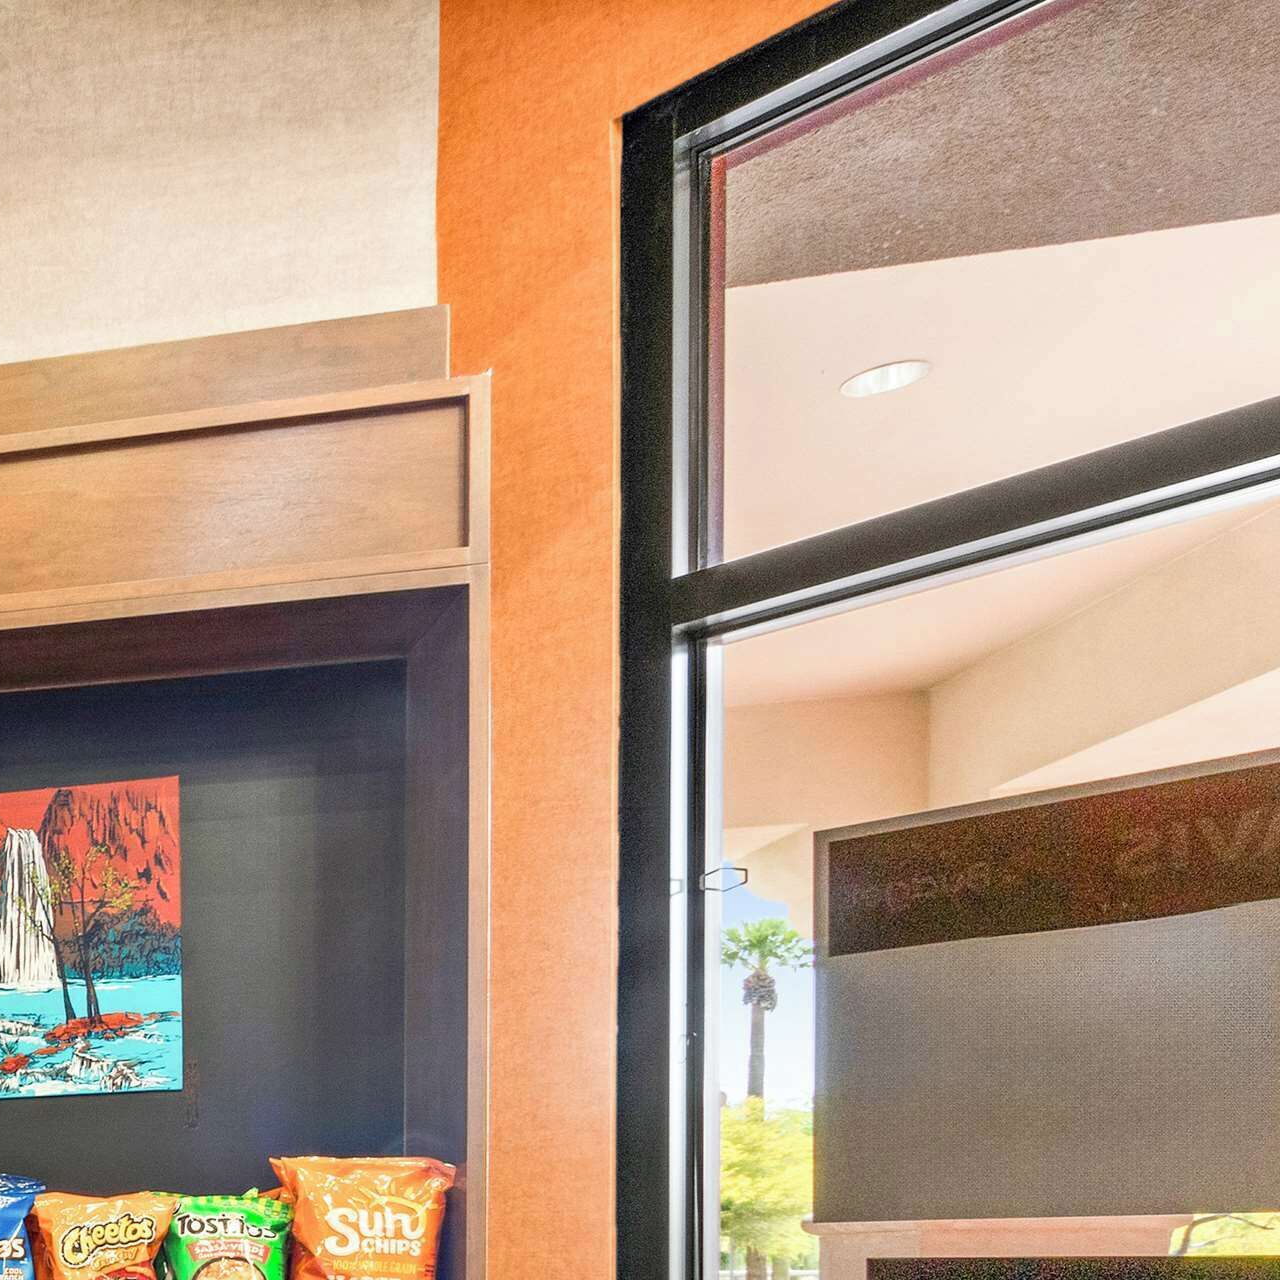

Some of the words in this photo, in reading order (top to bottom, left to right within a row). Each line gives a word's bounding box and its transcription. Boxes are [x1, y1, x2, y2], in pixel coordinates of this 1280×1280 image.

[61, 1215, 154, 1266] Cheetos
[324, 1206, 427, 1257] Sun
[358, 1237, 423, 1257] CHIPS
